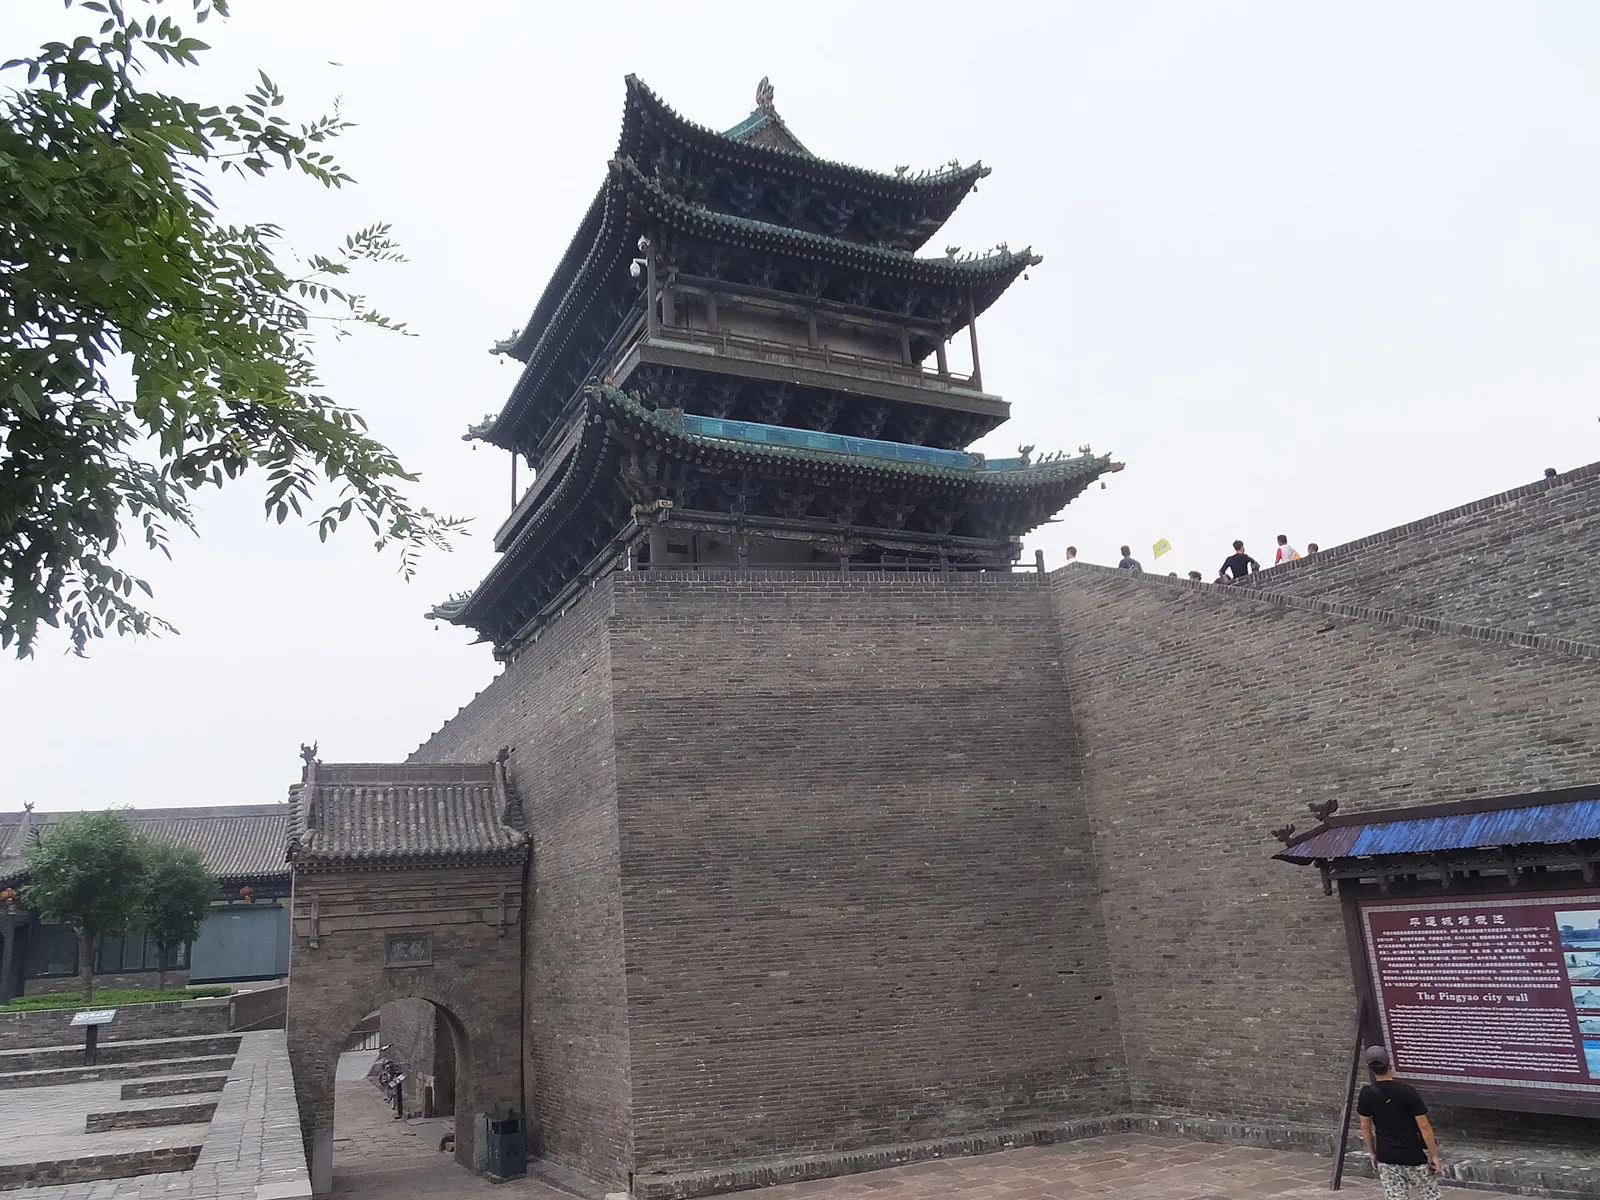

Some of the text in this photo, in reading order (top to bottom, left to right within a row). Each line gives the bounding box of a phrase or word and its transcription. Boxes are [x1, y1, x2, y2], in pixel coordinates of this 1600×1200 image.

[1416, 992, 1529, 1003] The Pingyao city wall
